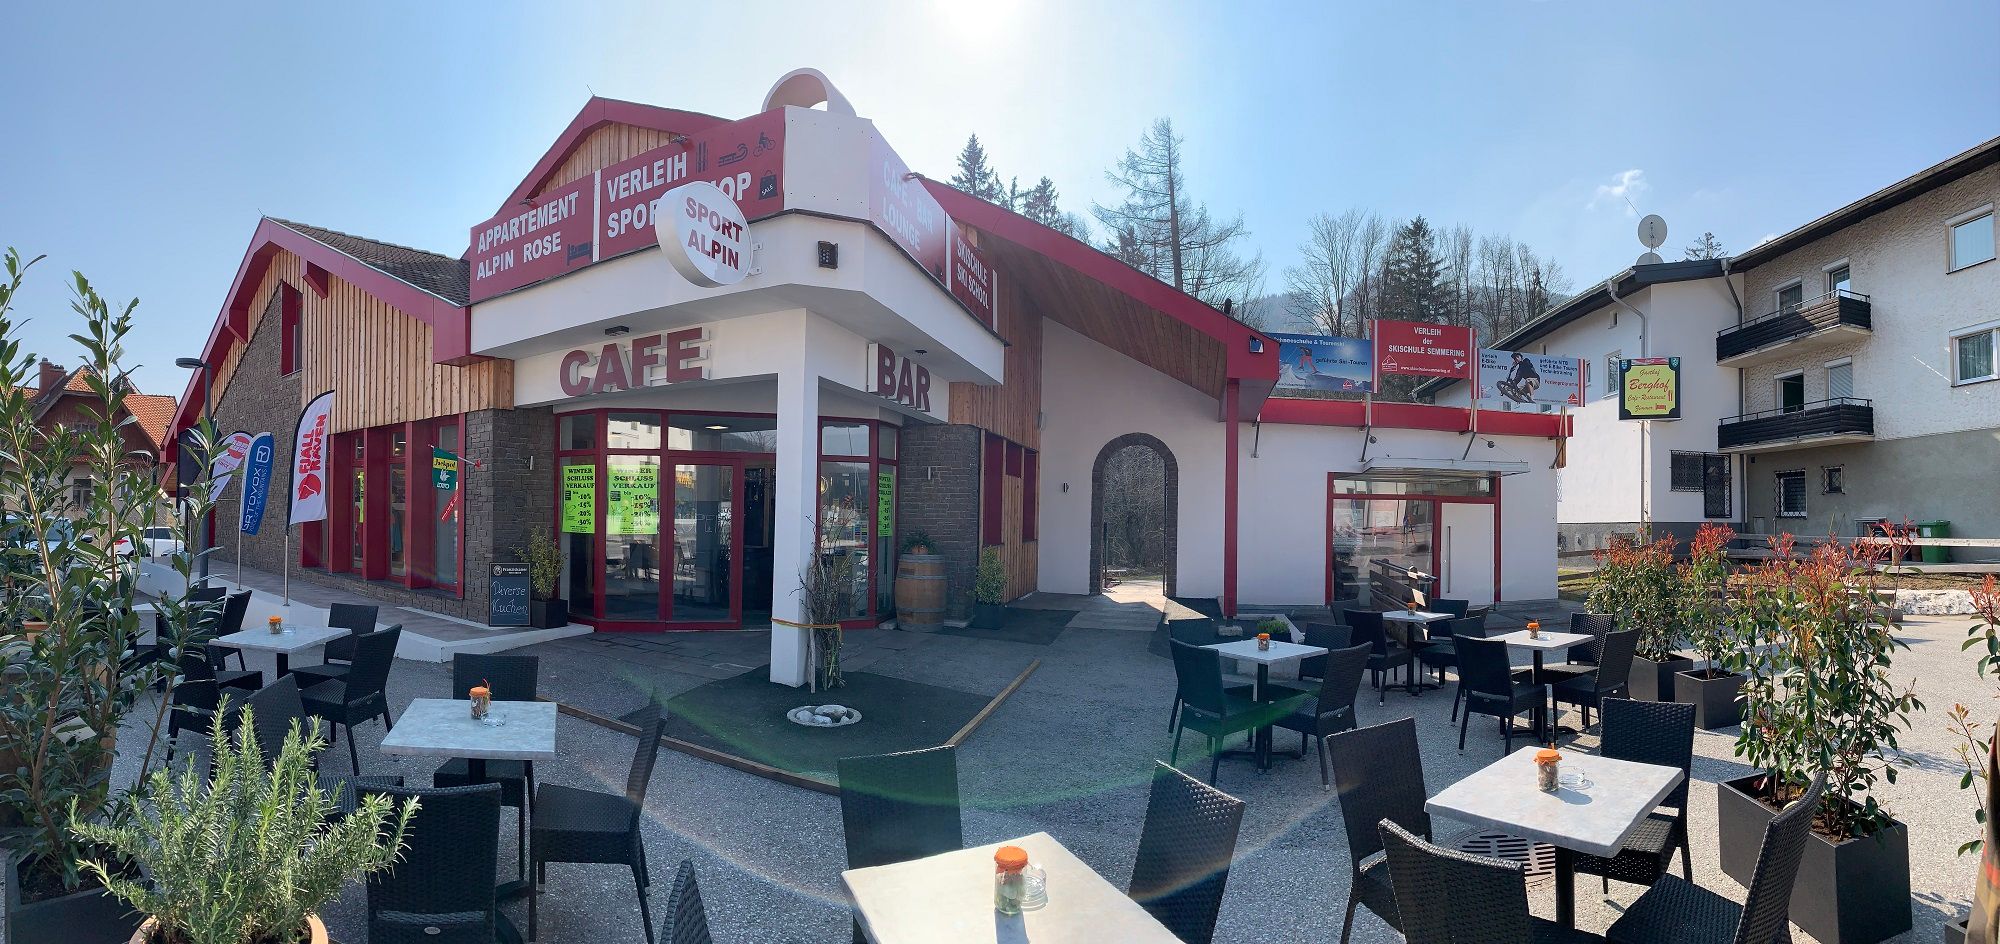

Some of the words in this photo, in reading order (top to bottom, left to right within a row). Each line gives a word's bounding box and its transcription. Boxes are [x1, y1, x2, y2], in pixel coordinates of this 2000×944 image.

[607, 152, 687, 202] VERLEIH
[762, 183, 773, 196] SALE
[882, 160, 908, 207] CAFE
[916, 198, 934, 234] BAR
[477, 191, 579, 254] APPARTEMENT
[607, 199, 660, 238] SPOR
[685, 197, 743, 243] SPORT
[882, 197, 920, 251] LOUNGE
[477, 249, 514, 281] ALPIN
[523, 231, 562, 263] ROSE
[688, 229, 739, 270] ALPIN
[957, 237, 988, 288] SKISCHULE
[957, 263, 968, 287] SKI
[968, 274, 989, 310] SCHOOL
[1388, 344, 1425, 354] SKISCHULE
[1427, 347, 1465, 357] SEMMERING
[1413, 326, 1442, 336] VERLEIH
[1422, 337, 1432, 345] der
[560, 327, 704, 397] CAFE
[877, 343, 931, 412] BAR
[1629, 378, 1670, 392] Berghof
[299, 429, 315, 474] FJÄLL
[310, 414, 327, 471] RÄVEN
[434, 459, 456, 469] Jackpot
[630, 501, 651, 509] -15%
[491, 580, 526, 596] Diverse
[491, 598, 528, 616] Kuchen
